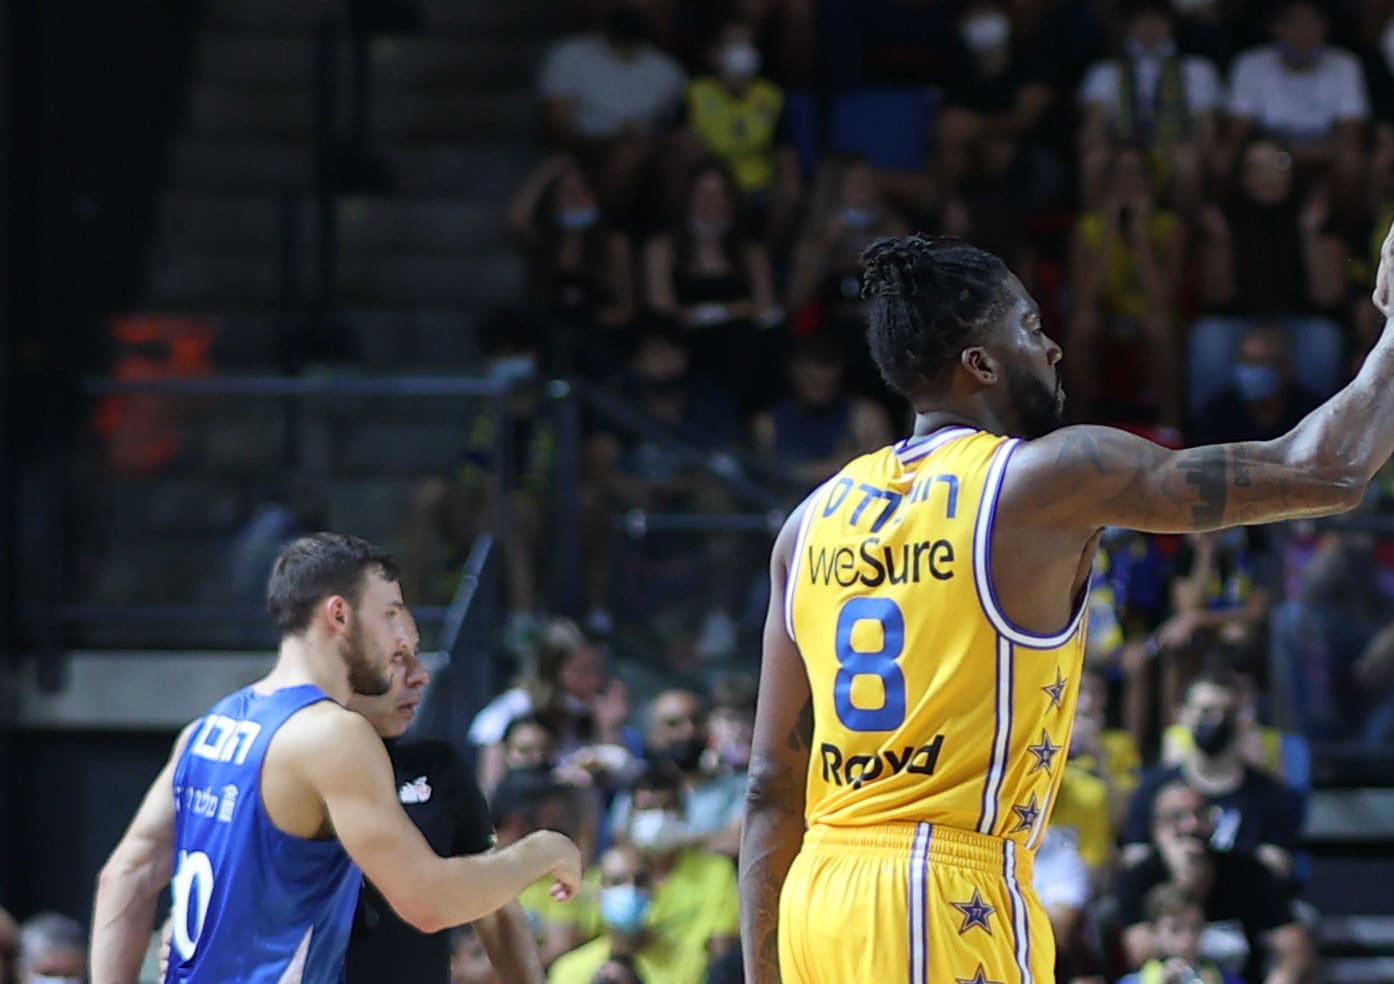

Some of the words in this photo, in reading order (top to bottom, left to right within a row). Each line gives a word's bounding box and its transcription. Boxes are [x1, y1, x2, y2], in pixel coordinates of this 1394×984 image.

[809, 537, 955, 588] weSure
[833, 597, 905, 732] 8
[172, 849, 215, 961] 0
